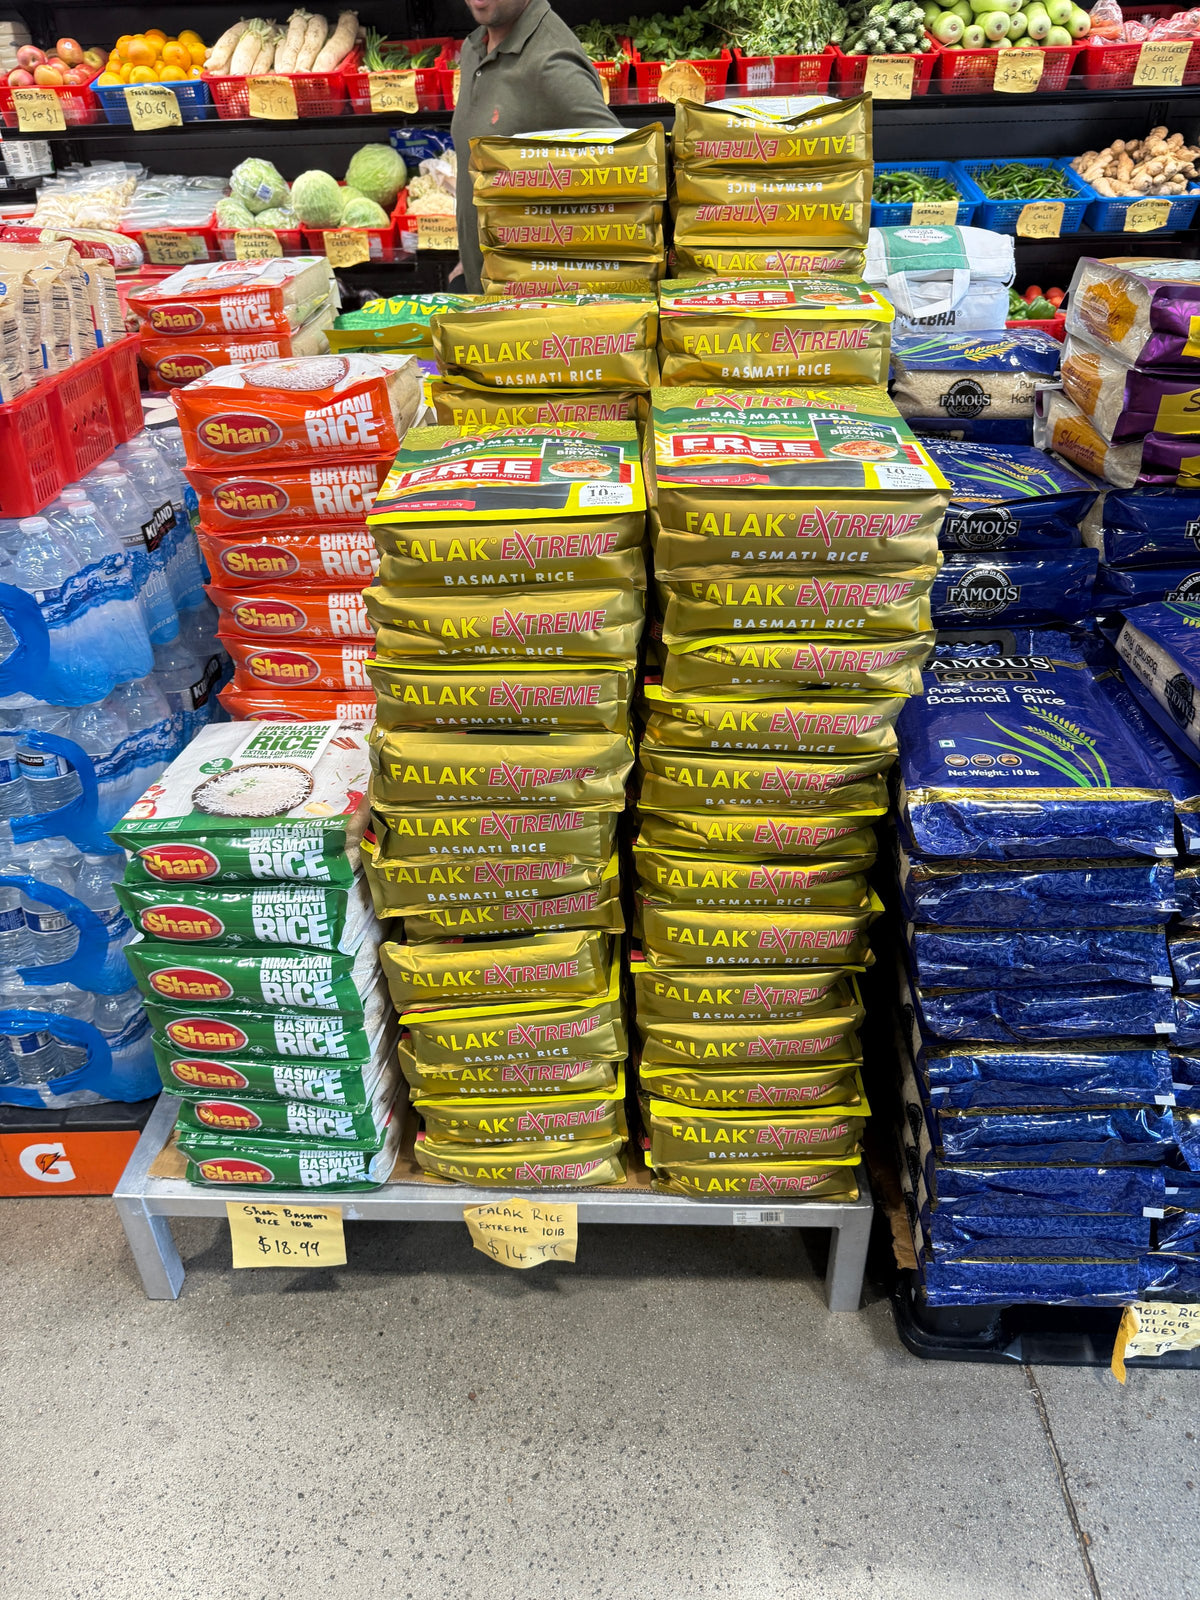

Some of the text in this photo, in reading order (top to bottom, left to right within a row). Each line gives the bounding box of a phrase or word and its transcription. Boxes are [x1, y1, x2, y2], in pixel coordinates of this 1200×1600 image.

[520, 145, 615, 159] BASMATI RICE
[695, 132, 779, 163] EXTREME
[492, 162, 573, 192] EXTREME
[727, 183, 823, 194] BASMATI RICE
[695, 198, 779, 226] EXTREME
[497, 218, 575, 247] EXTREME
[220, 305, 276, 331] RICE
[541, 332, 637, 368] EXTREME
[684, 325, 870, 361] FALAK EXTREME
[495, 368, 603, 386] BASMATI RICE
[722, 364, 832, 379] BASMATI RICE
[940, 394, 991, 406] FAMOUS
[710, 412, 798, 420] BASMATI
[205, 424, 272, 445] Shan
[304, 412, 379, 448] RICE
[682, 437, 815, 454] FREE
[310, 464, 378, 486] BIRYANI
[216, 491, 278, 511] Shan
[950, 520, 1018, 535] FAMOUS
[501, 530, 619, 569] EXTREME
[730, 550, 870, 562] BASMATI RICE
[226, 552, 289, 572] Shan
[444, 572, 575, 586] BASMATI RICE
[950, 587, 1018, 602] FAMOUS
[236, 608, 297, 627] Shan
[491, 608, 607, 645] EXTREME
[732, 618, 866, 629] BASMATI RICE
[250, 658, 310, 678] Shan
[941, 671, 1030, 682] GOLD
[488, 680, 602, 715] EXTREME
[926, 694, 1066, 706] Basmati Rice
[928, 686, 1056, 696] Pure Long Grain
[479, 810, 586, 842] EXTREME
[511, 843, 547, 854] RICE
[250, 848, 330, 880] RICE
[427, 888, 540, 902] BASMATI RICE
[776, 898, 812, 906] RICE
[252, 902, 327, 918] BASMATI
[146, 912, 212, 935] Shan
[252, 914, 331, 945] RICE
[706, 956, 820, 965] BASMATI RICE
[260, 968, 333, 983] BASMATI
[484, 960, 579, 989] EXTREME
[154, 974, 221, 997] Shan
[260, 980, 338, 1008] RICE
[692, 1011, 803, 1020] BASMATI RICE
[170, 1025, 236, 1042] Shan
[274, 1019, 344, 1034] BASMATI
[275, 1030, 348, 1057] RICE
[464, 1048, 569, 1063] BASMATI RICE
[176, 1064, 238, 1086] Shan
[274, 1076, 346, 1102] RICE
[288, 1116, 357, 1139] RICE
[20, 1142, 76, 1183] G
[299, 1158, 365, 1172] BASMATI
[255, 1217, 280, 1226] RICE
[478, 1207, 564, 1223] FALAK RICE
[479, 1222, 529, 1234] EXTREME
[258, 1236, 320, 1257] $18.99
